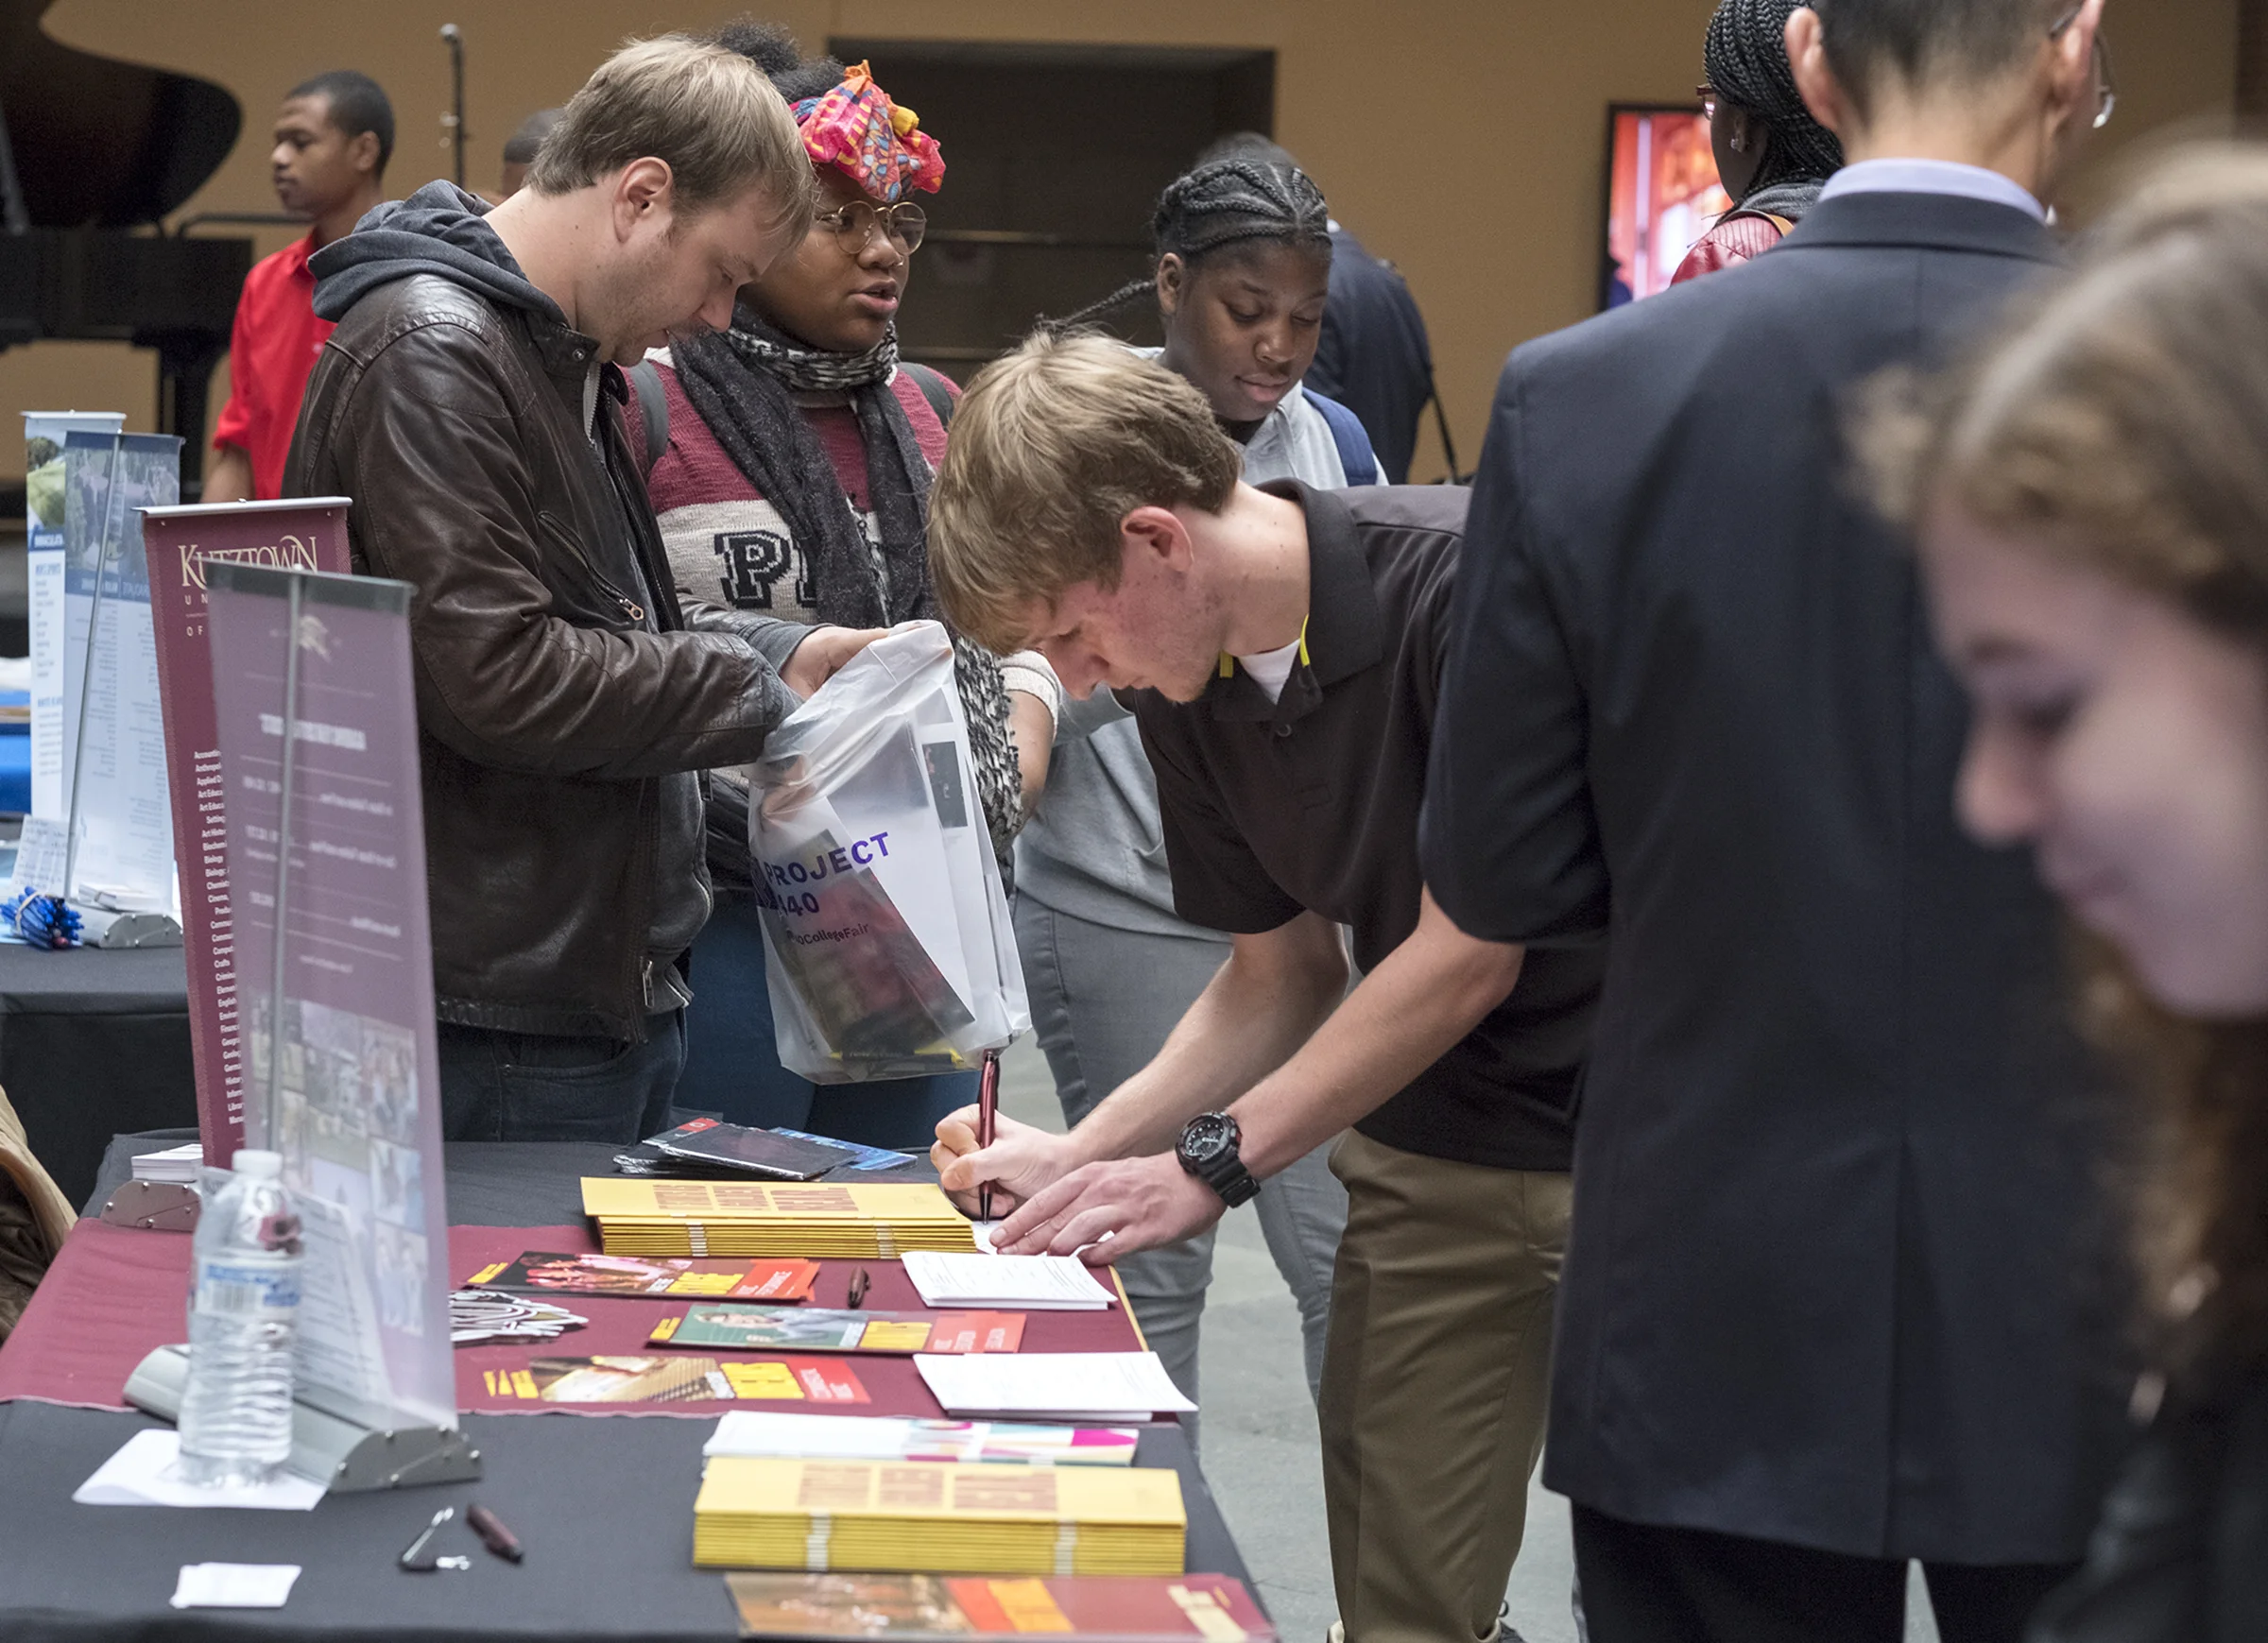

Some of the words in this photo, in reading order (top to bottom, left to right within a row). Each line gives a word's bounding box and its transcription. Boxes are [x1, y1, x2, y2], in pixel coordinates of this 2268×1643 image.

[178, 535, 318, 590] KUOWN
[186, 625, 203, 637] OF
[764, 831, 889, 885] PROJECT
